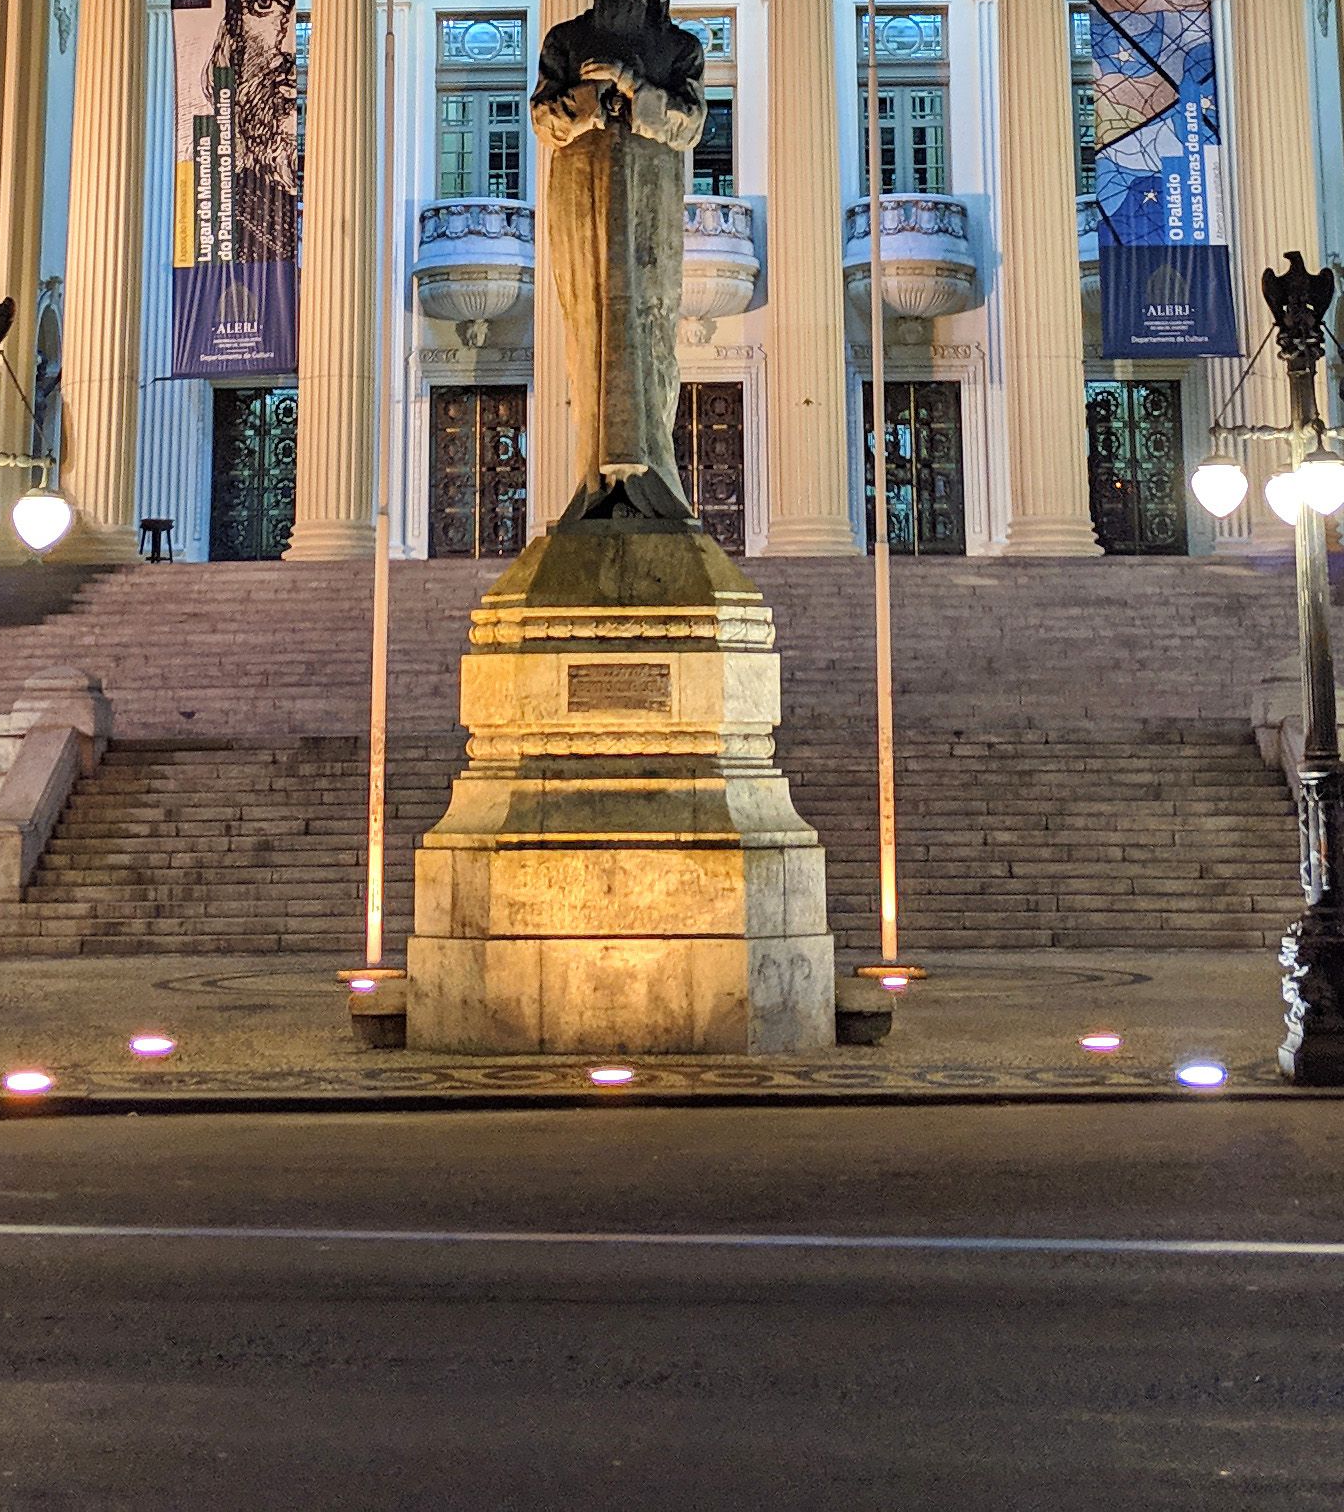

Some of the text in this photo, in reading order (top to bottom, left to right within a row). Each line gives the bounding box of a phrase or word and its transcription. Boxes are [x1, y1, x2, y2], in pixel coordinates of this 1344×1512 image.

[195, 136, 214, 262] Lugar de Memória
[216, 88, 233, 261] do Parlamento Brasileiro
[1166, 173, 1184, 241] O Palácio
[1184, 101, 1205, 240] e suas obras de arte
[1146, 304, 1190, 317] ALERJ
